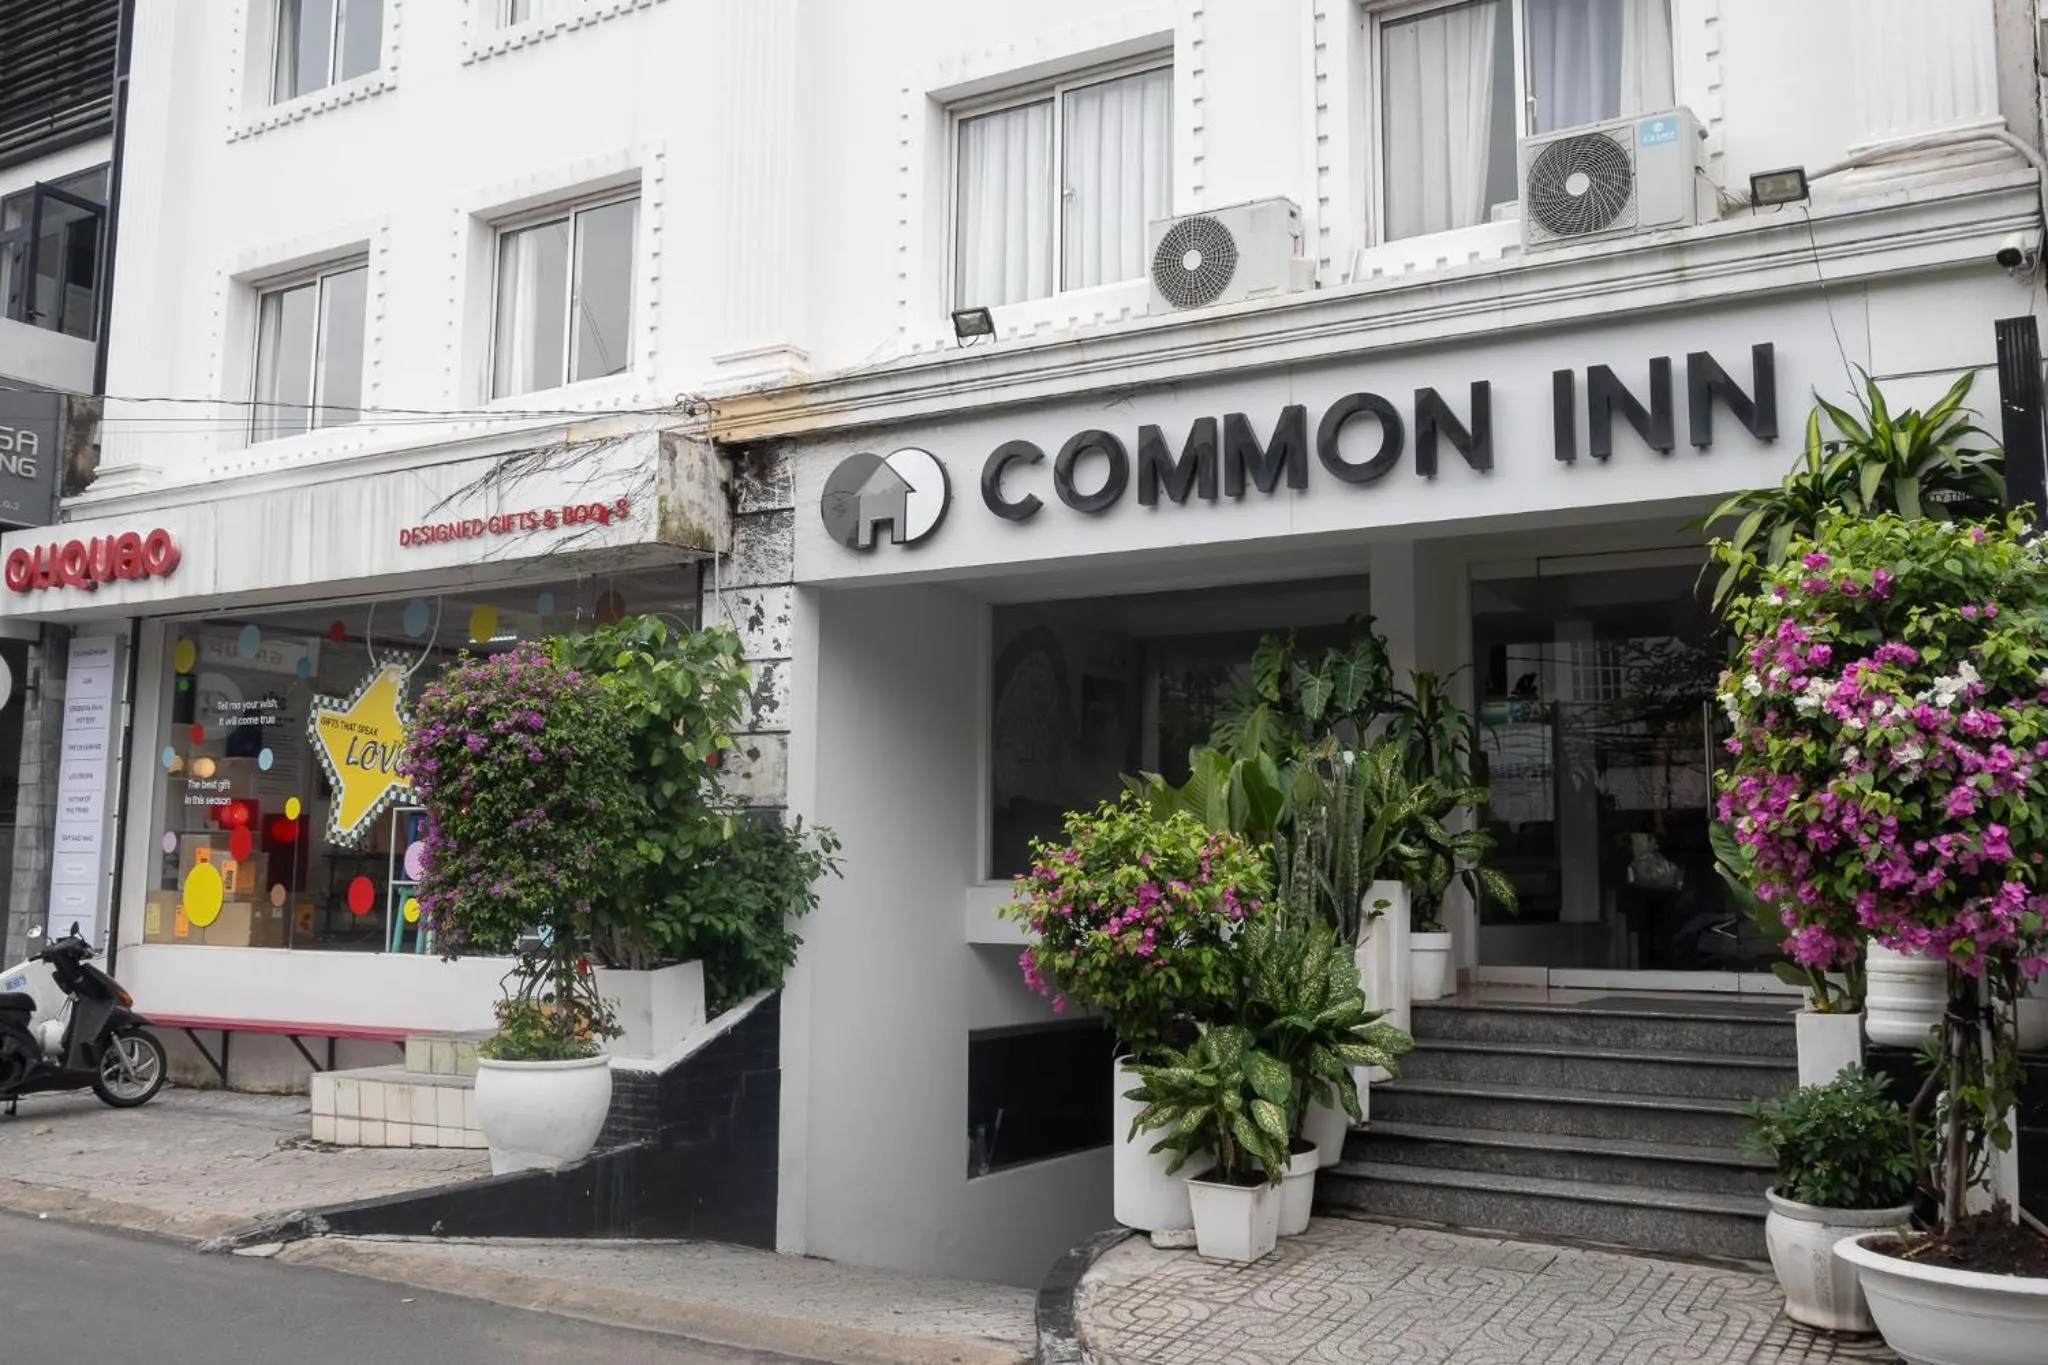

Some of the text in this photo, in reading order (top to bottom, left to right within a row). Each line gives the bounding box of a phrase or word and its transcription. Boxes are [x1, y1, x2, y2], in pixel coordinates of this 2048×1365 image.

[981, 342, 1778, 521] COMMON INN
[400, 517, 485, 546] DESIGNED
[487, 509, 538, 535] GIFTS
[543, 508, 558, 530] &
[242, 700, 259, 713] your
[225, 715, 237, 726] will
[238, 716, 259, 726] come
[260, 715, 276, 725] true
[320, 717, 379, 738] GIFTS THAT SPEAK
[187, 779, 230, 793] The best gift
[192, 795, 205, 805] this
[205, 796, 231, 806] season
